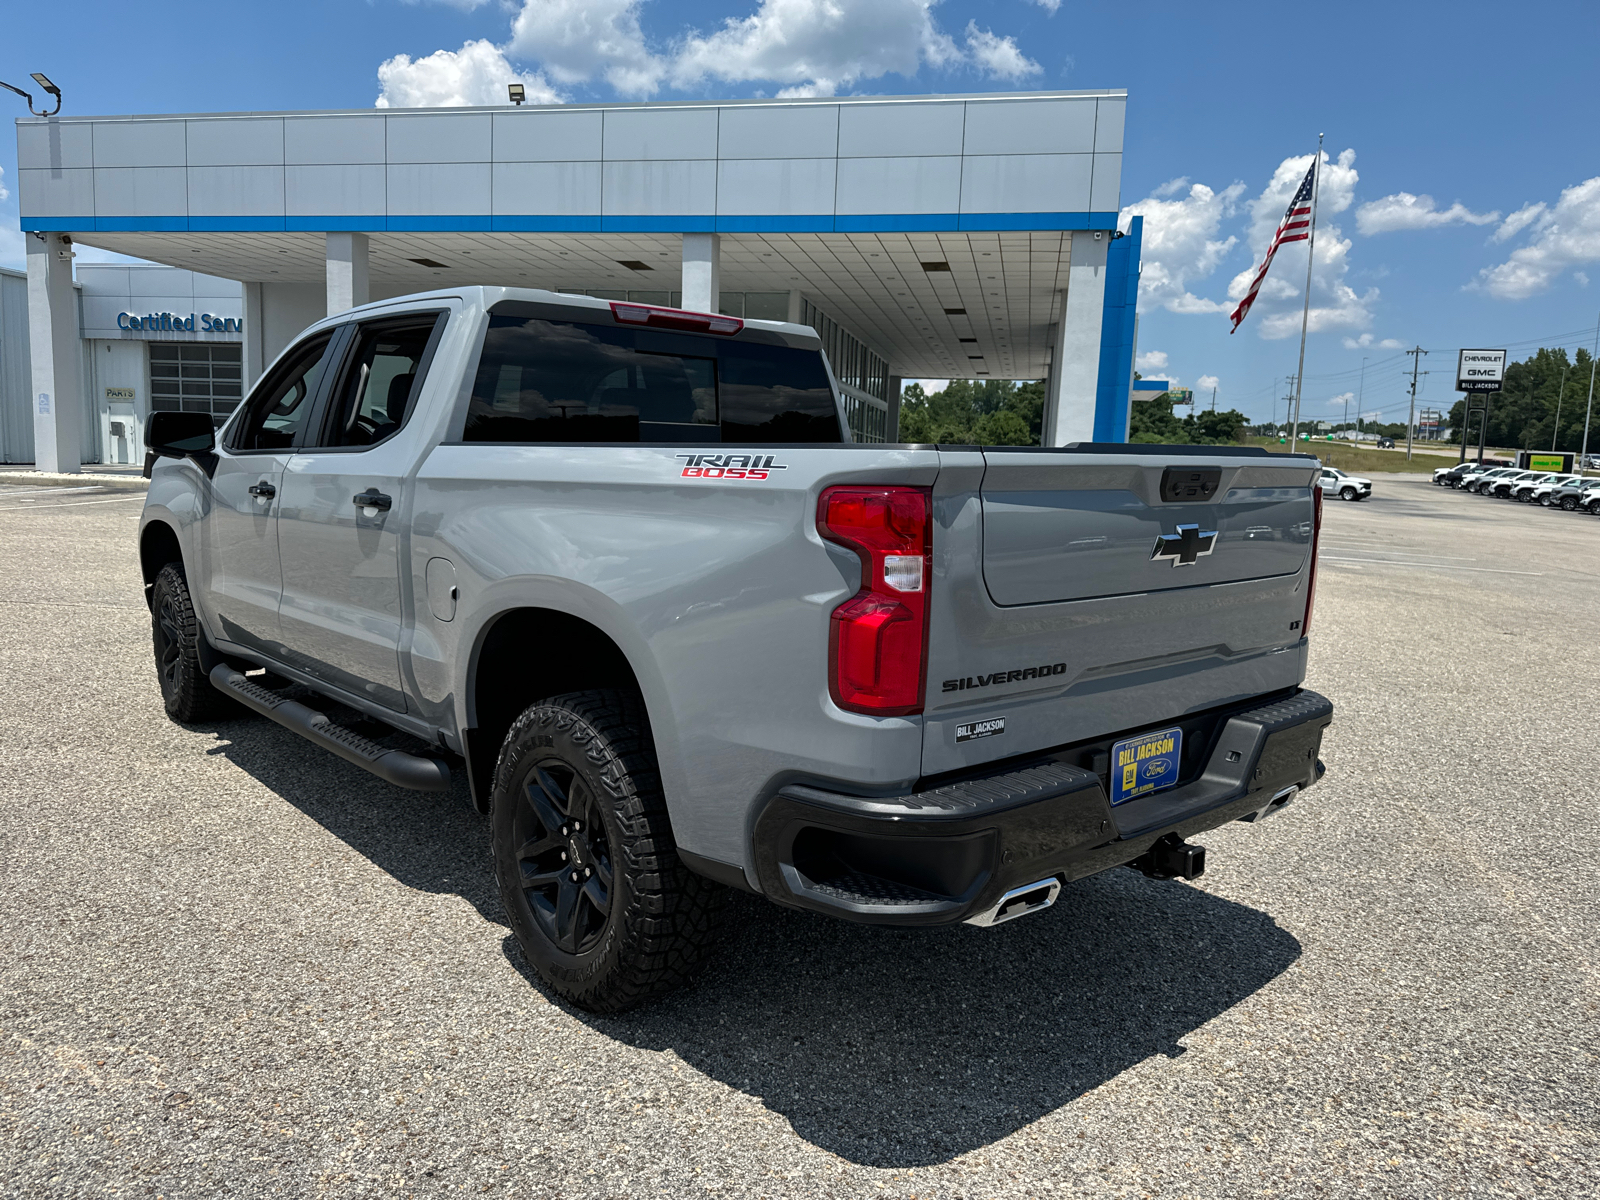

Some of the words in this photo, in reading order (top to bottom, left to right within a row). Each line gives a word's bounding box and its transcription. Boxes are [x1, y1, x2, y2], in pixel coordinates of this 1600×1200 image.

[117, 312, 195, 332] Certified
[1464, 355, 1502, 363] CHEVROLET
[1467, 369, 1496, 377] GMC
[106, 389, 134, 398] PARTS
[675, 454, 788, 470] TRAIL
[680, 467, 770, 481] BOSS
[1289, 620, 1302, 630] LT
[942, 663, 1067, 692] SILVERADO
[957, 725, 972, 737] BILL
[973, 719, 1005, 734] JACKSON
[1129, 740, 1143, 748] LICENSE
[1143, 736, 1157, 744] APPLIED
[1118, 748, 1135, 767] BILL
[1136, 738, 1174, 761] JACKSON
[1125, 768, 1135, 781] GM
[1146, 761, 1167, 777] Ford
